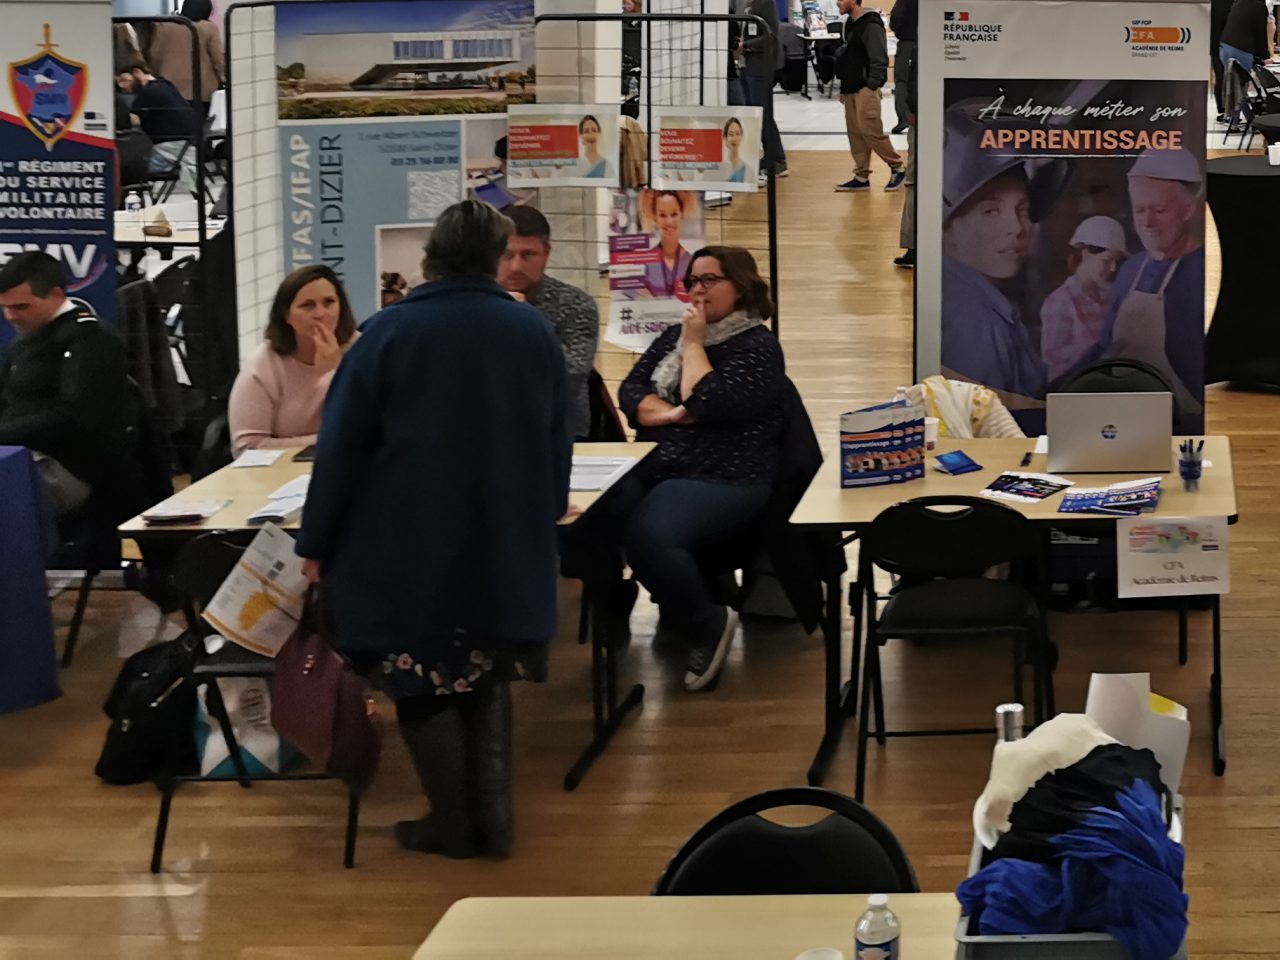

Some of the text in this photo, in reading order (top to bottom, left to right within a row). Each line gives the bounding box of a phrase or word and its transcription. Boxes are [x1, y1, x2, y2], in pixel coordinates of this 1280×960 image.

[943, 23, 1003, 34] RÉPUBLIQUE
[943, 33, 999, 43] FRANÇAISE
[978, 87, 1188, 125] À chaque métier son
[979, 128, 1184, 151] APPRENTISSAGE
[18, 160, 106, 174] RÉGIMENT
[26, 176, 106, 189] SERVICE
